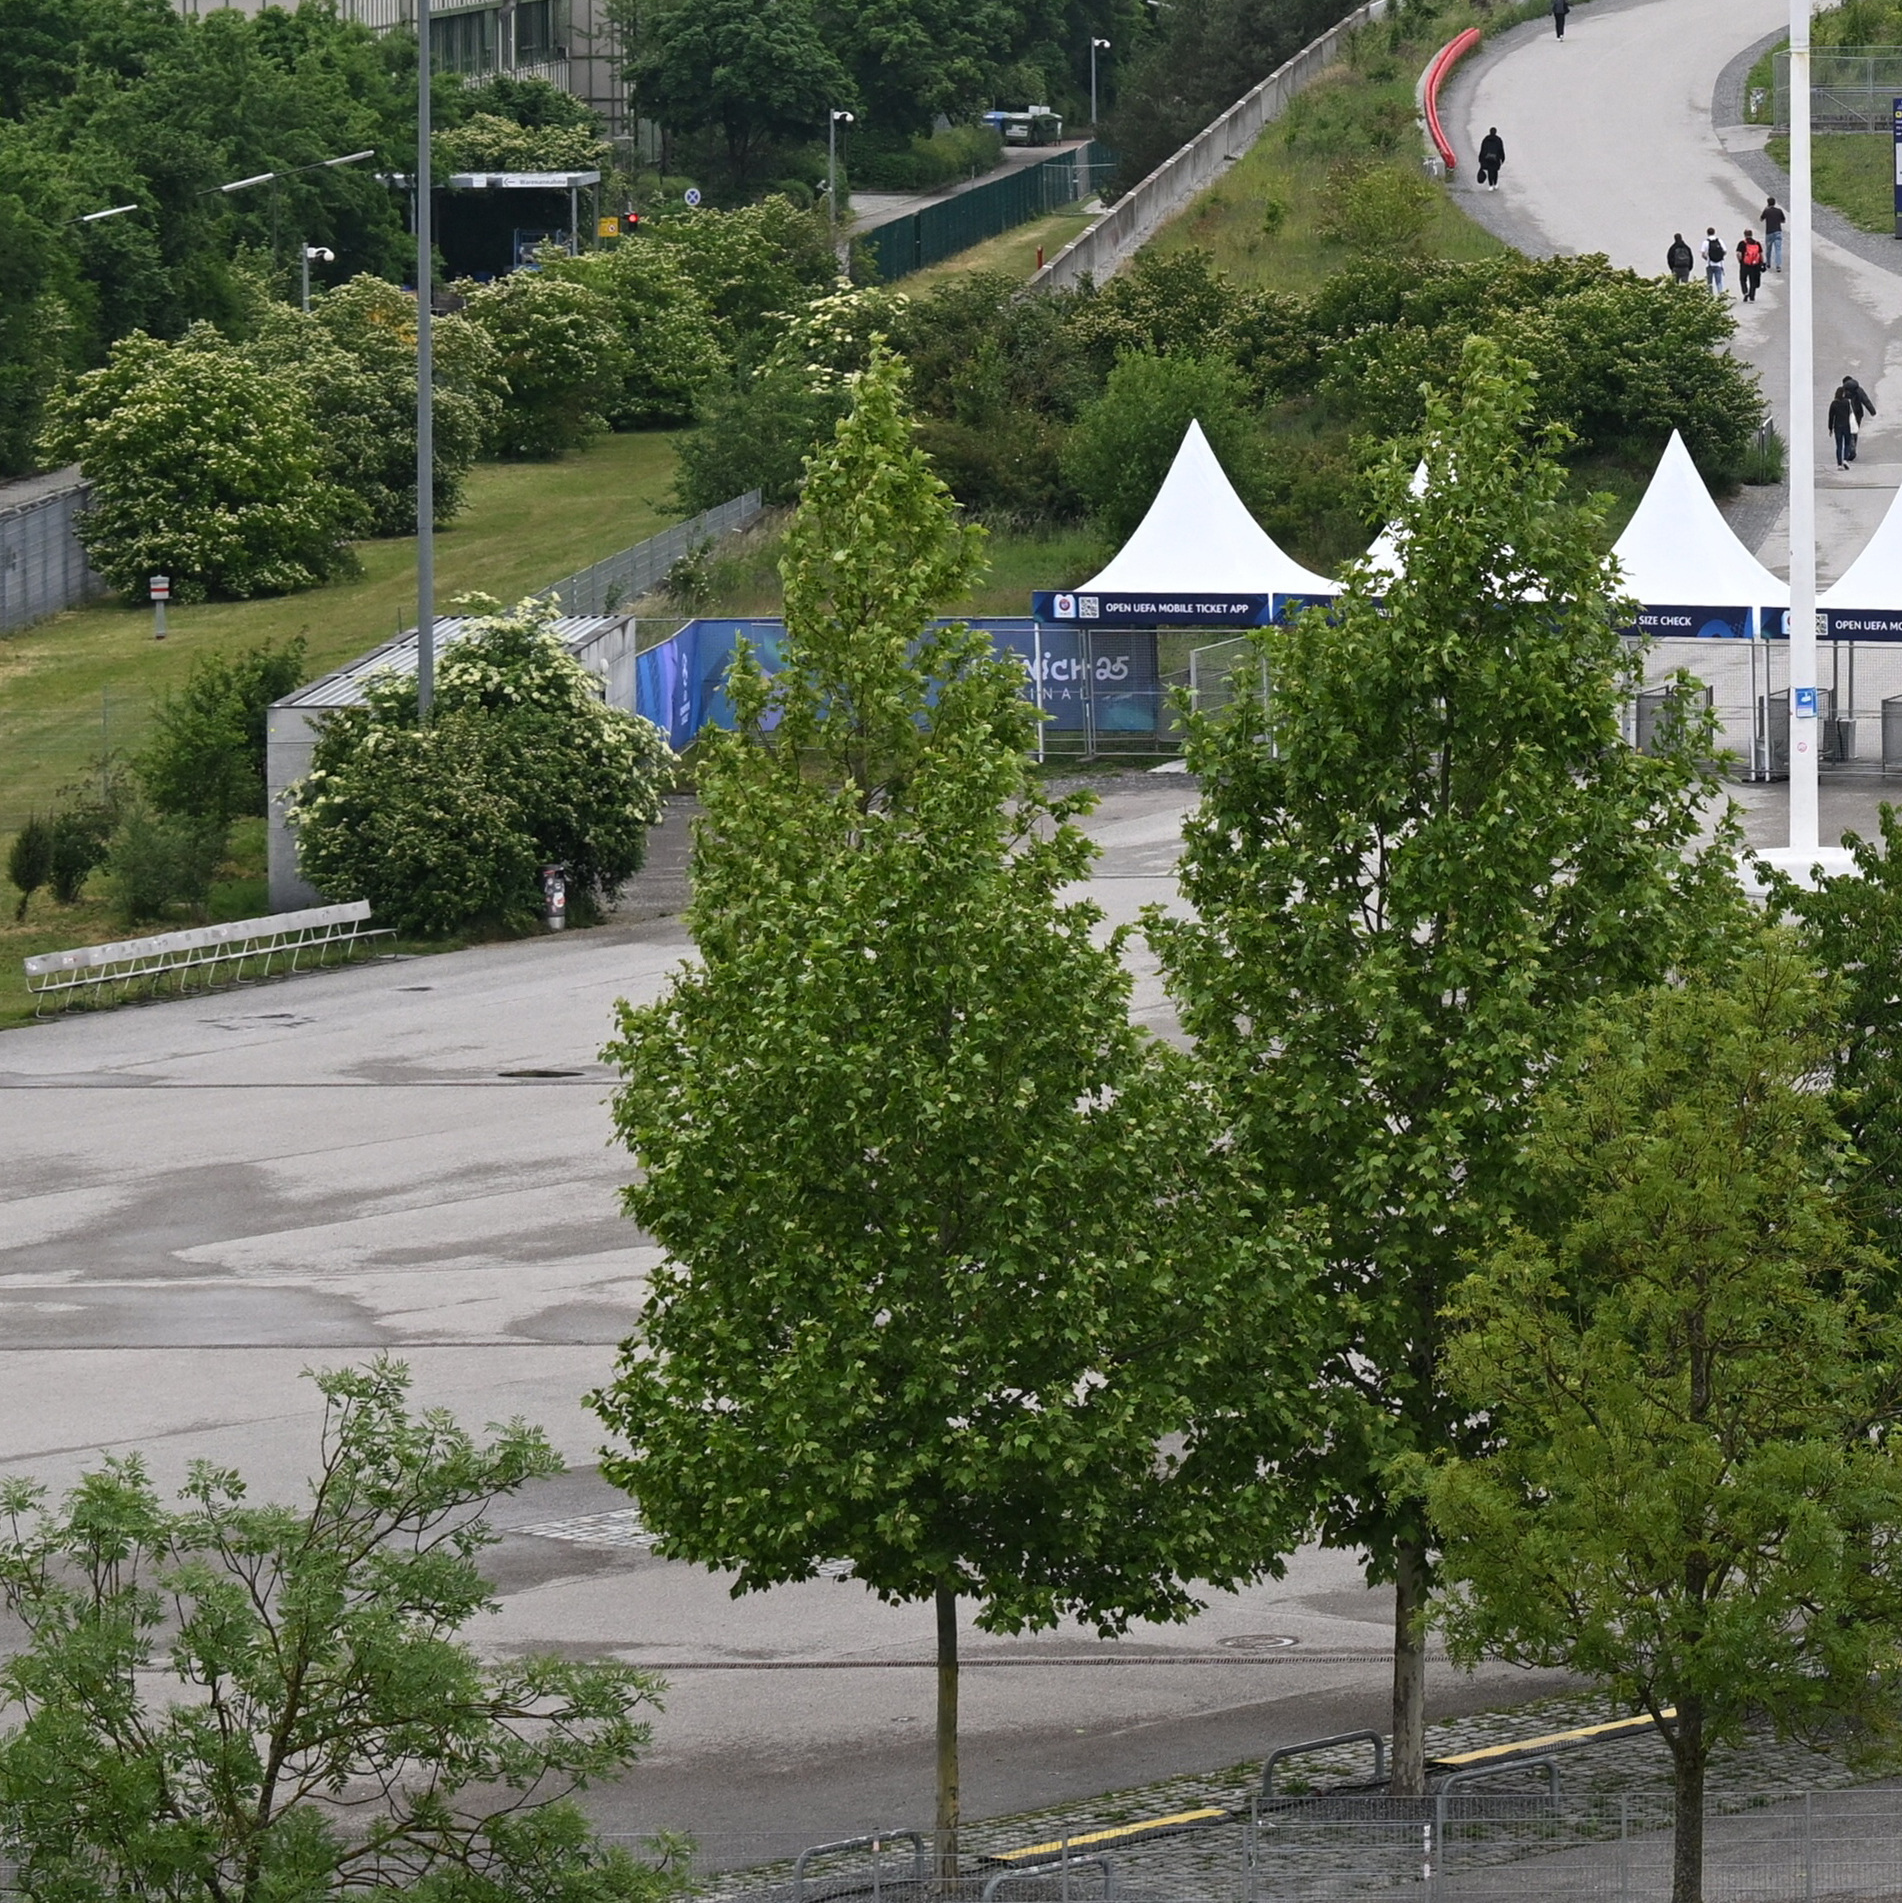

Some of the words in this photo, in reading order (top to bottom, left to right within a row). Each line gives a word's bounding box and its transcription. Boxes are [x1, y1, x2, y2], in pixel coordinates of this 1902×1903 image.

[1105, 602, 1132, 613] OPEN
[1133, 603, 1157, 613] UEFA
[1158, 603, 1193, 614] MOBILE
[1195, 603, 1228, 614] TICKET
[1230, 603, 1249, 614] APP
[1638, 615, 1659, 625] SIZE
[1660, 616, 1692, 626] CHECK
[1834, 619, 1861, 631] OPEN
[1863, 620, 1889, 632] UEFA
[1095, 656, 1130, 681] 25
